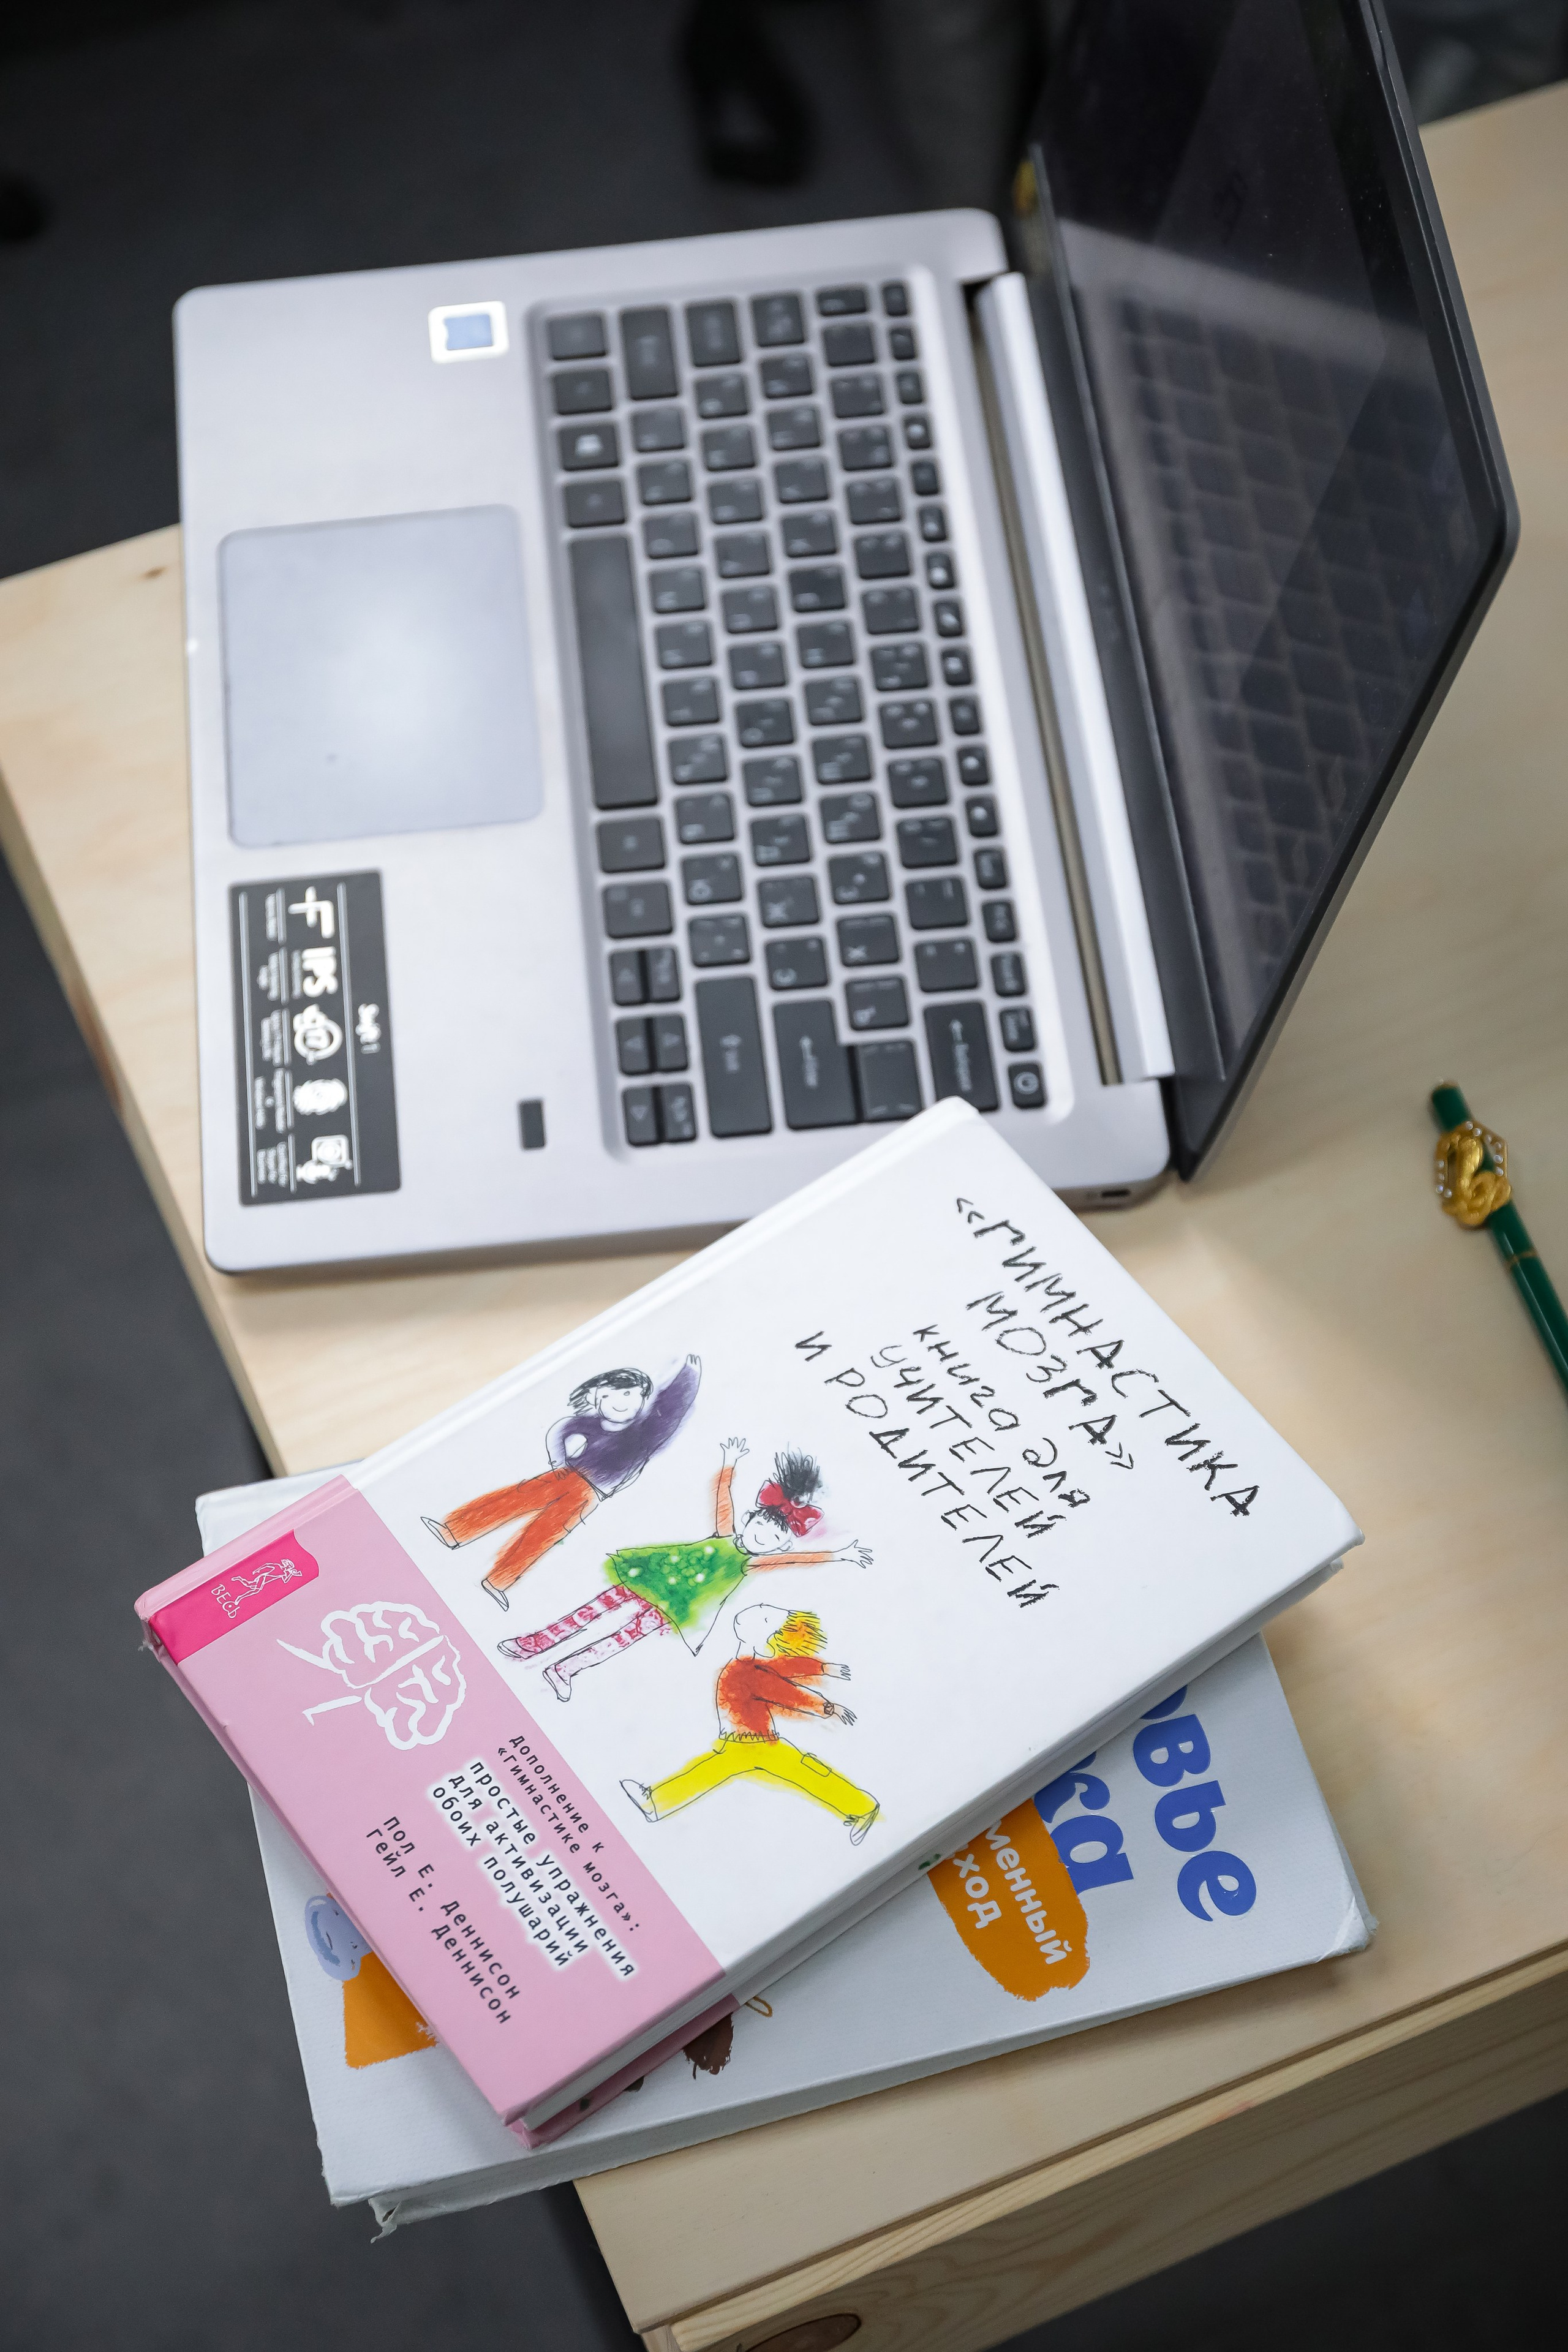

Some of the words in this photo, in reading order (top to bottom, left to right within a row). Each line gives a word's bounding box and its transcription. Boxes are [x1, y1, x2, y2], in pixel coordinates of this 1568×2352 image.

[302, 946, 337, 998] IPS
[870, 1345, 1067, 1539] УЧИТЕЛЕЙ
[913, 1324, 1020, 1431] книга
[956, 1197, 1260, 1517] «ГИМНАСТИКА
[966, 1291, 1135, 1470] МОЗГА»
[795, 1330, 832, 1361] И
[824, 1367, 1060, 1608] РОДИТЕЛЕЙ
[211, 1584, 240, 1619] ВЕСЬ
[433, 1787, 481, 1846] обоих
[484, 1856, 572, 1966] полушарий
[448, 1775, 483, 1810] для
[486, 1821, 588, 1953] активизации
[470, 1762, 535, 1844] простые
[536, 1854, 634, 1976] упражнения
[498, 1747, 580, 1853] «Гимнастике
[582, 1861, 639, 1931] мозга»:
[508, 1735, 589, 1833] Дополнение
[592, 1842, 605, 1853] к
[366, 1828, 406, 1877] Гейл
[409, 1887, 425, 1912] Е.
[431, 1924, 510, 2023] Деннисон
[383, 1816, 415, 1854] Пол
[418, 1864, 434, 1888] Е.
[440, 1901, 519, 1999] Деннисон
